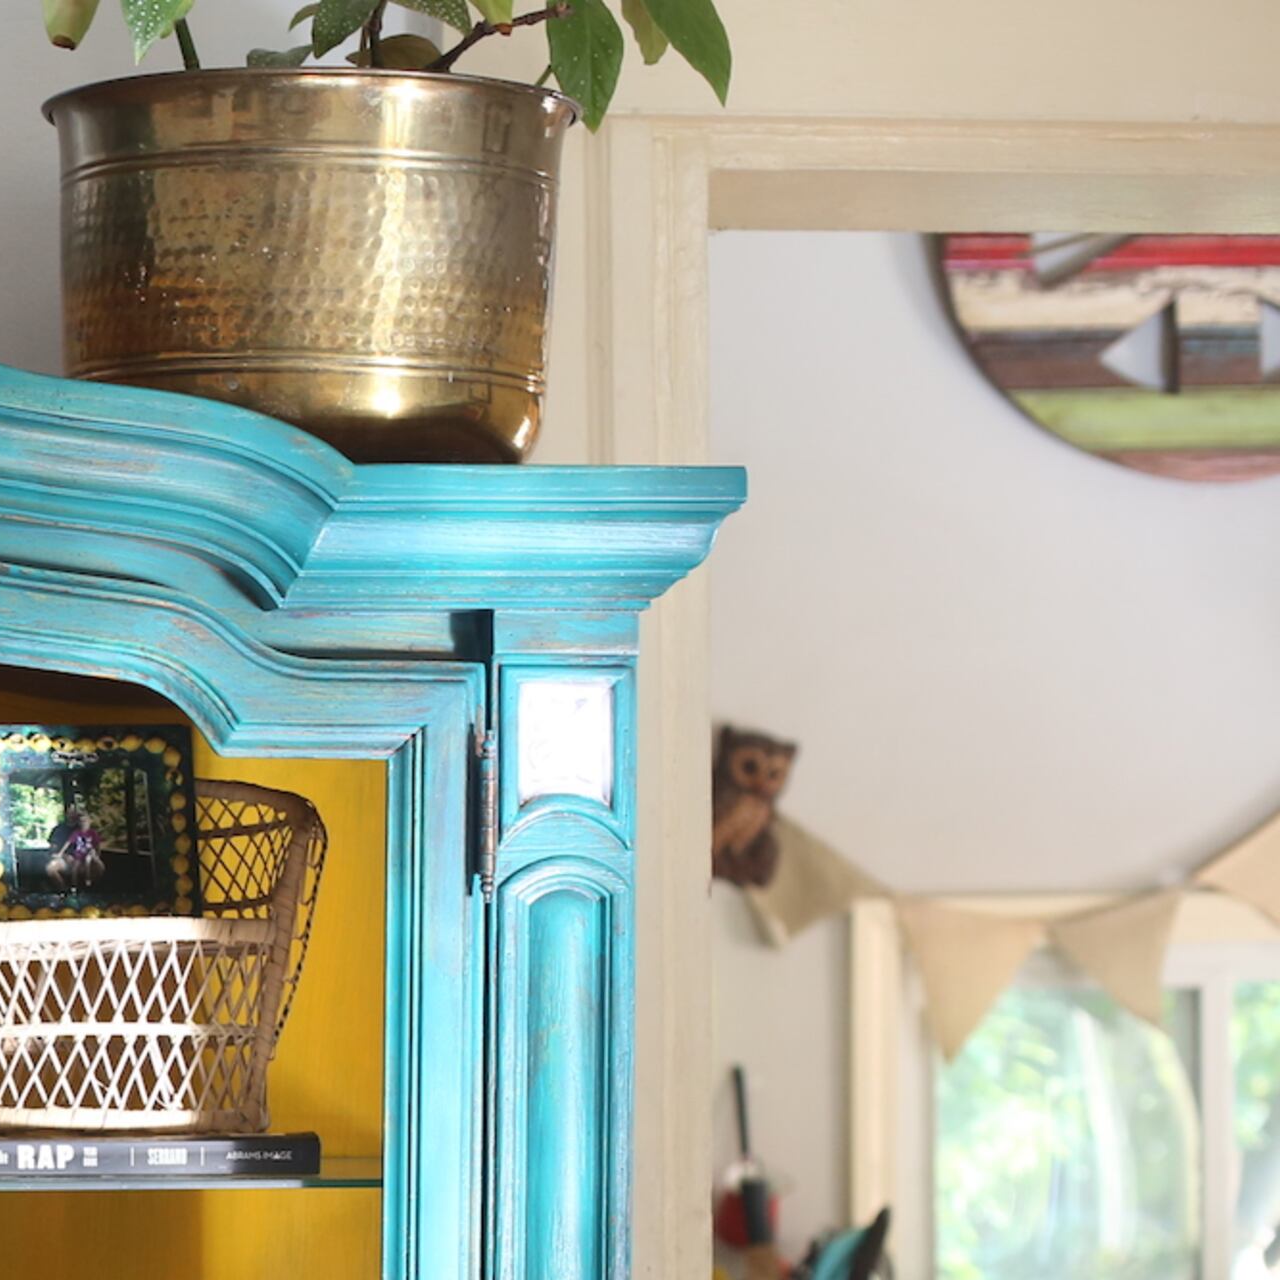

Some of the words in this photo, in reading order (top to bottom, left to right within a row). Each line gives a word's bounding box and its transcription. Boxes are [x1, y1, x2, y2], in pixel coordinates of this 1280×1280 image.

[16, 1144, 75, 1170] RAP
[225, 1150, 261, 1160] ABRAMS
[262, 1150, 293, 1160] IMAGE
